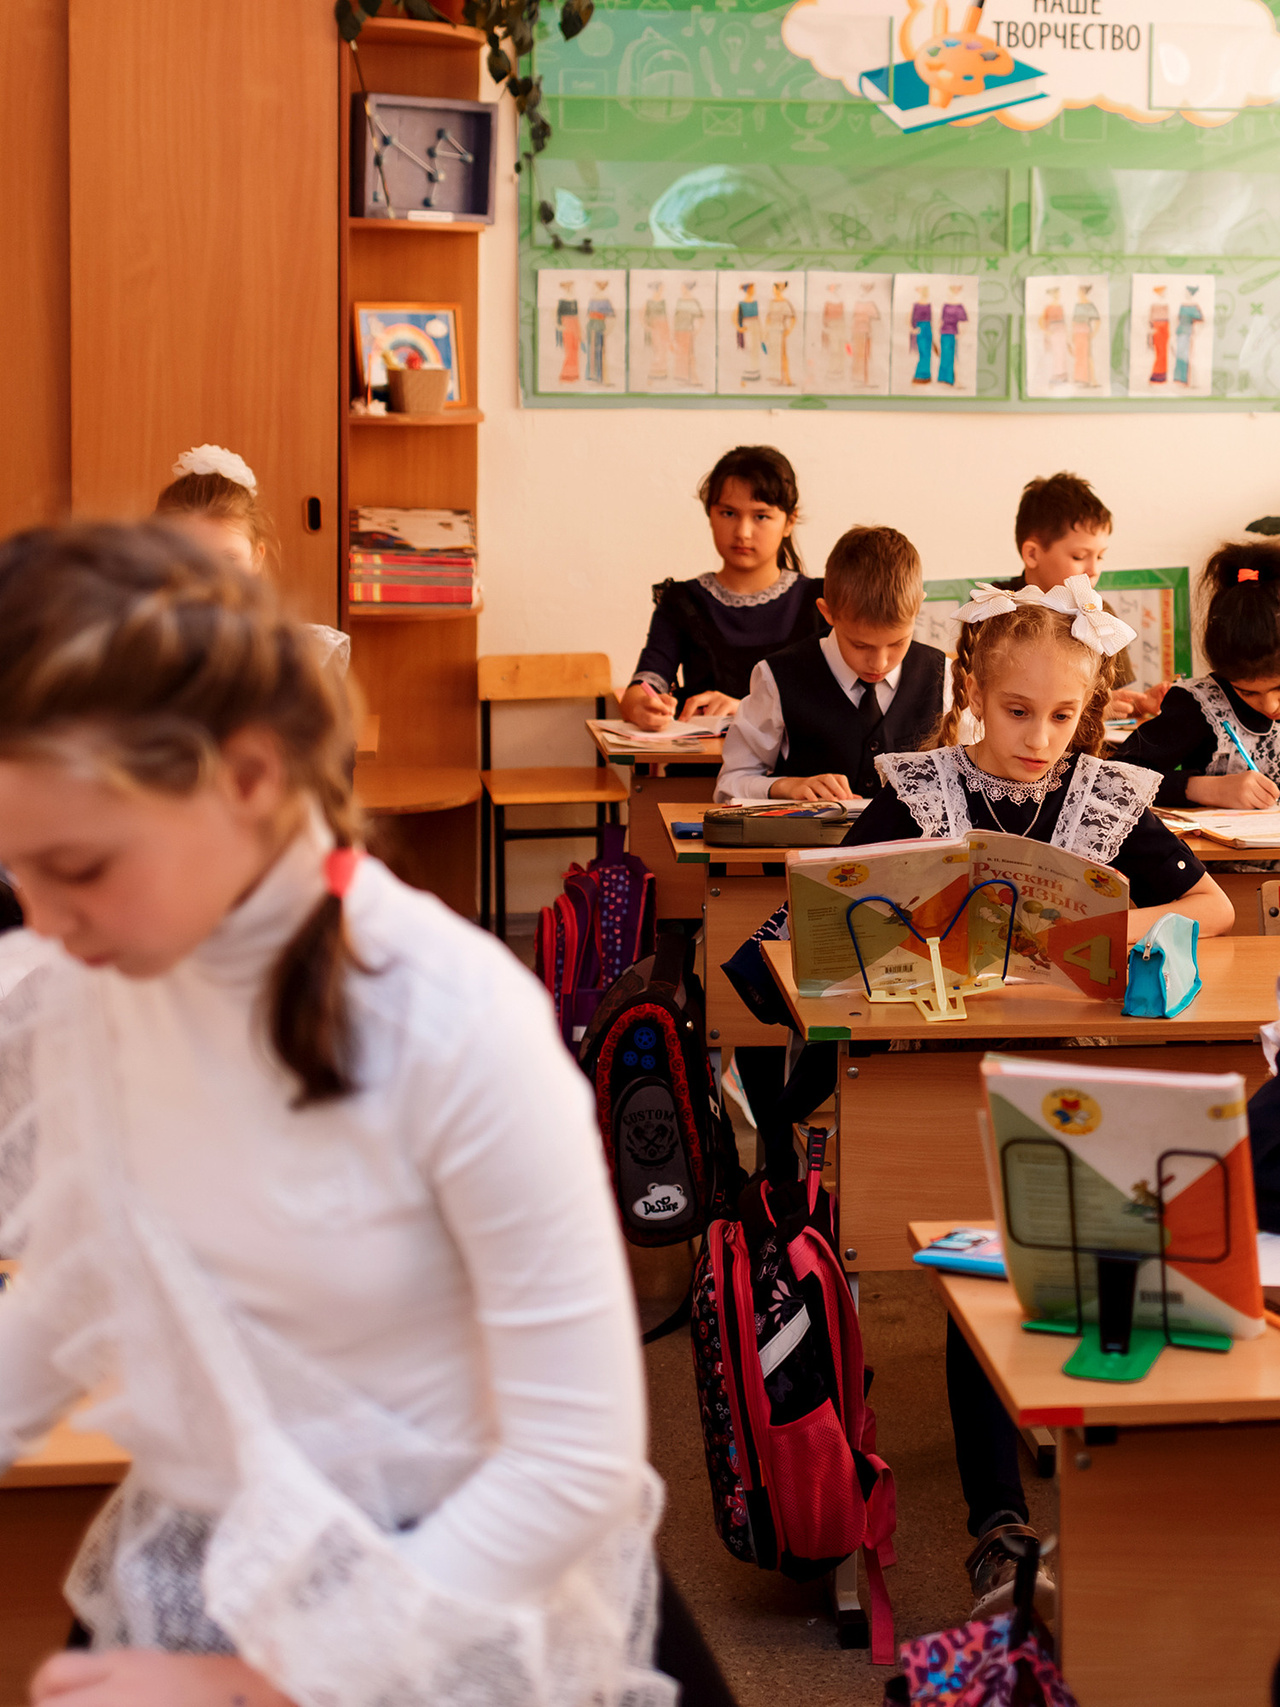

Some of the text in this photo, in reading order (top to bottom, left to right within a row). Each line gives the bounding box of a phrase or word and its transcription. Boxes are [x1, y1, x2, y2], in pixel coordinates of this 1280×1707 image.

[993, 21, 1141, 51] ТВОРЧЕСТВО
[972, 862, 1063, 892] Русский
[1063, 935, 1116, 985] 4
[623, 1109, 675, 1125] CUSTOM
